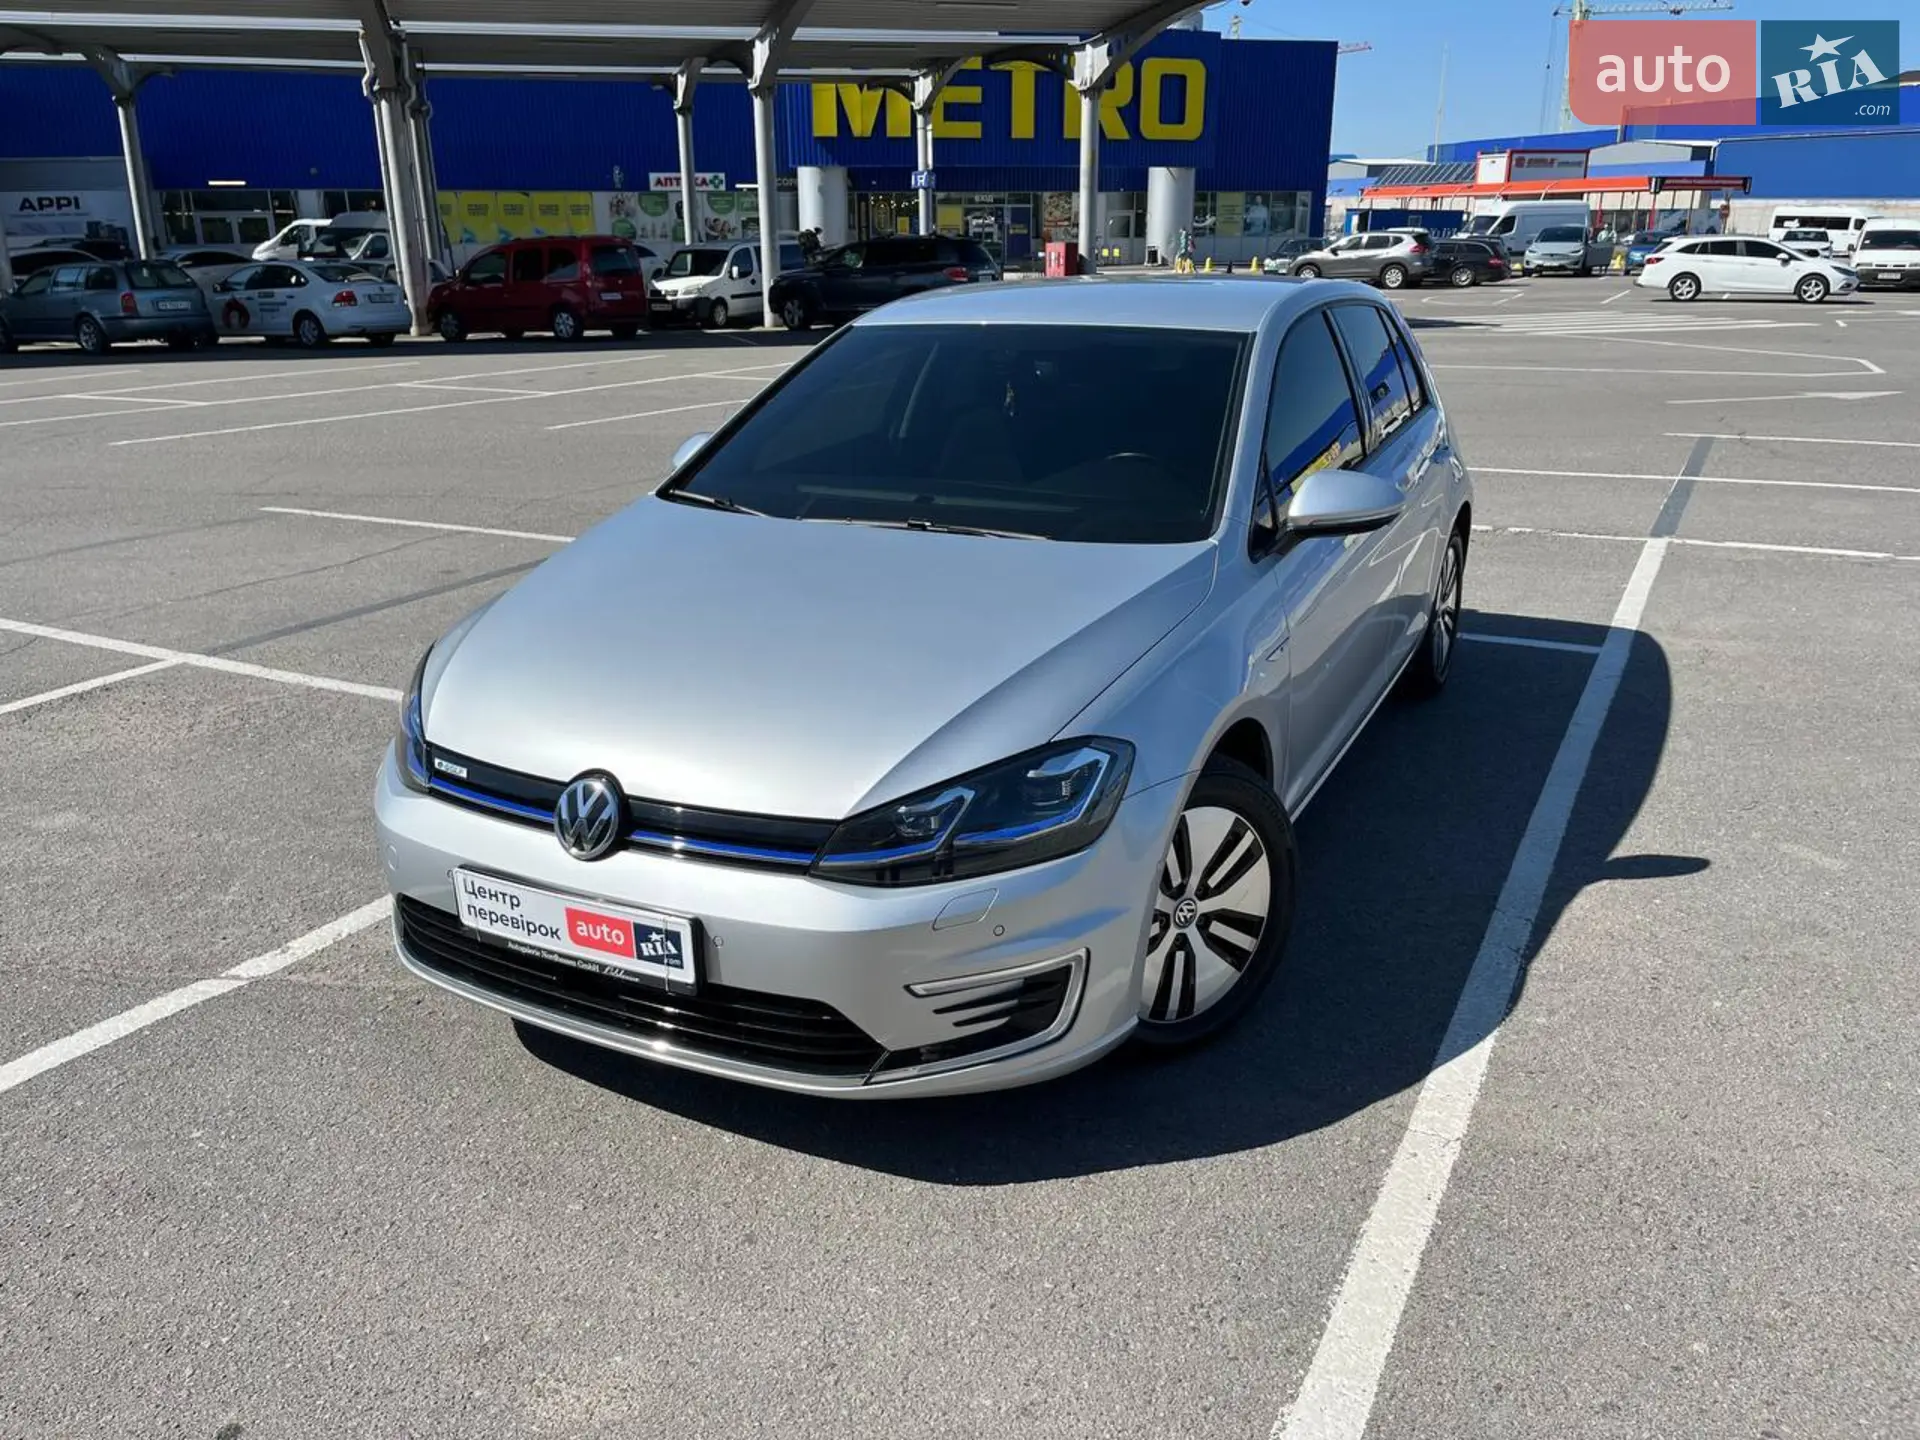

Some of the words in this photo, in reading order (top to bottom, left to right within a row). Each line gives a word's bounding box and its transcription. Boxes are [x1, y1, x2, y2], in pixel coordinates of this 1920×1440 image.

[811, 56, 1207, 141] METRO
[654, 176, 709, 188] АПТКА
[463, 877, 521, 911] Центр
[467, 904, 562, 941] перевірок
[576, 920, 625, 945] auto
[640, 939, 679, 957] RIA
